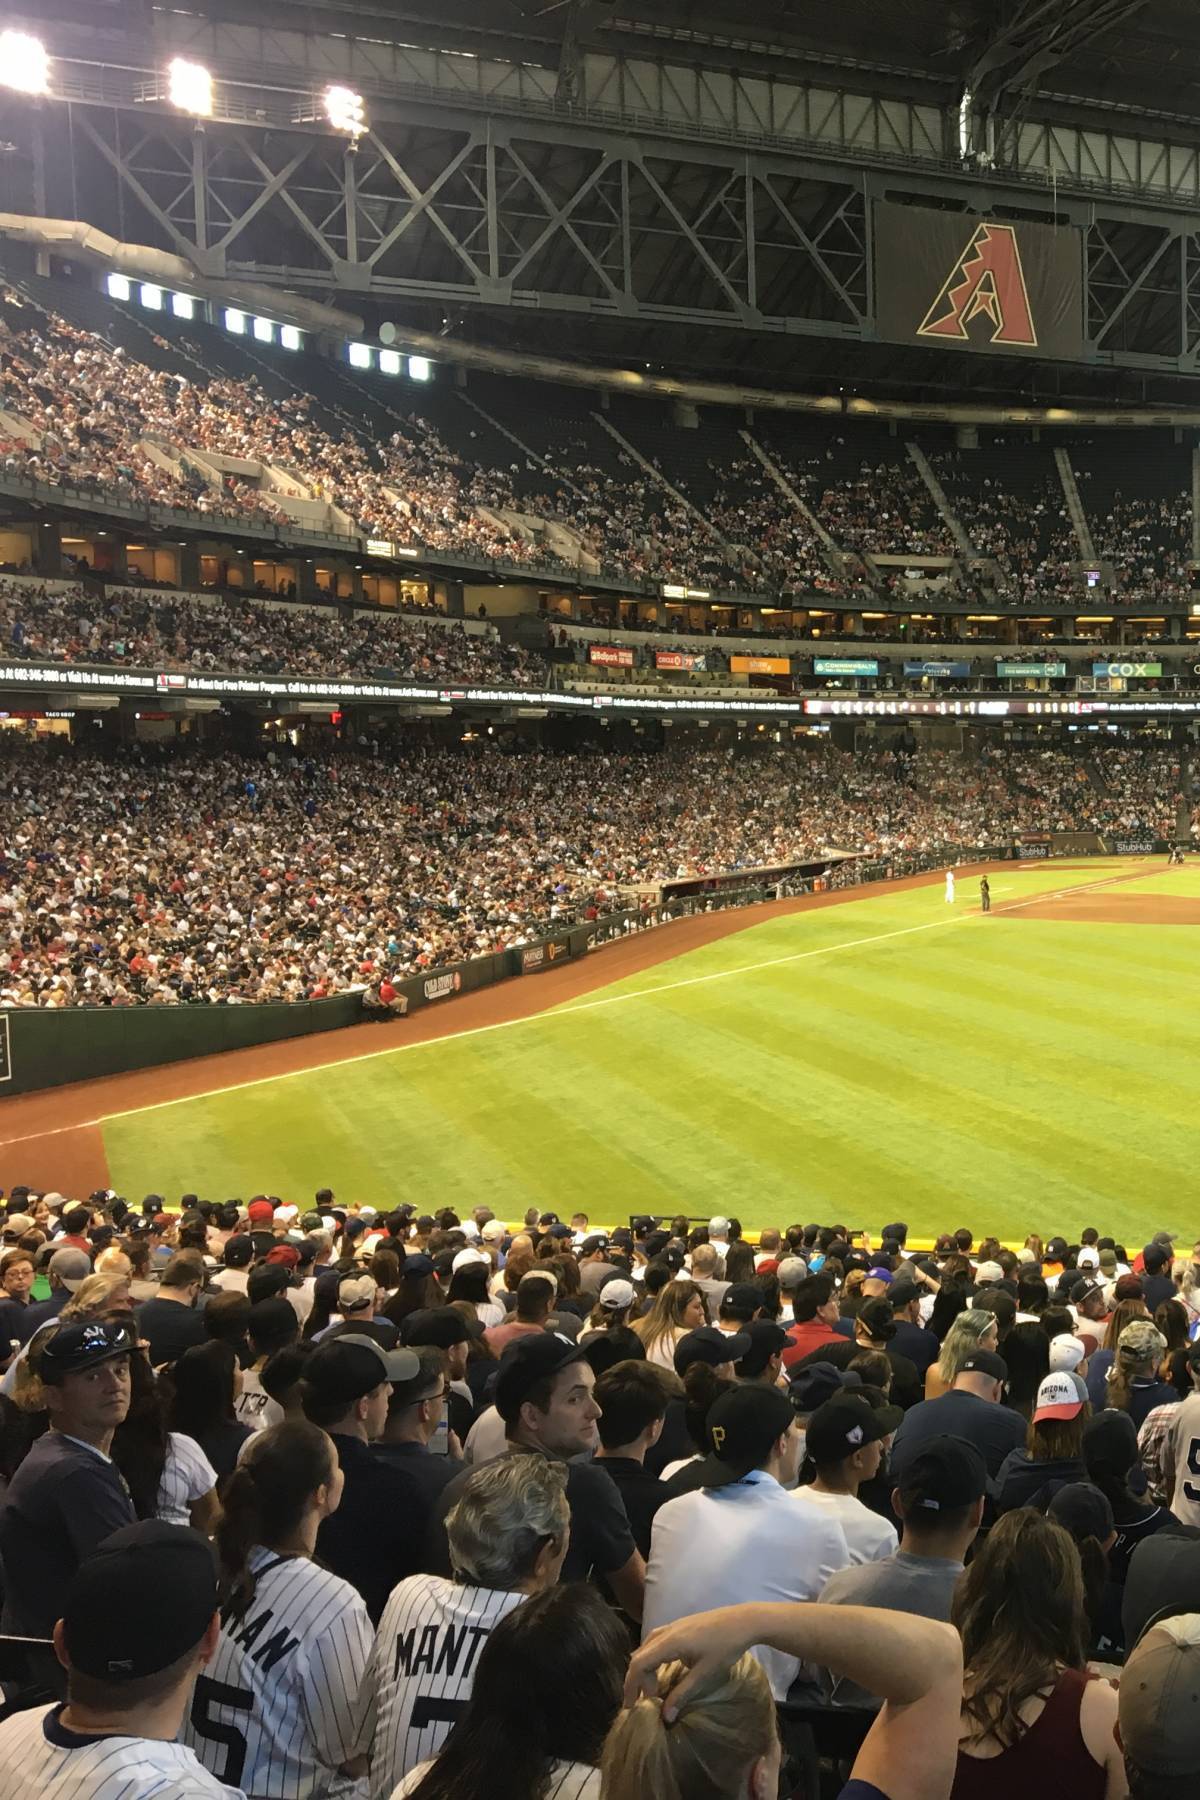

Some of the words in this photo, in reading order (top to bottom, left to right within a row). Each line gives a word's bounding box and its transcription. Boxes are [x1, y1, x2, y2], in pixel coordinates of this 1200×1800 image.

[1108, 663, 1147, 677] COX
[1019, 847, 1046, 858] StubHub
[1116, 843, 1153, 852] StubHub
[1040, 1384, 1069, 1397] ARIZONA
[712, 1416, 726, 1451] P
[393, 1624, 491, 1681] MANT
